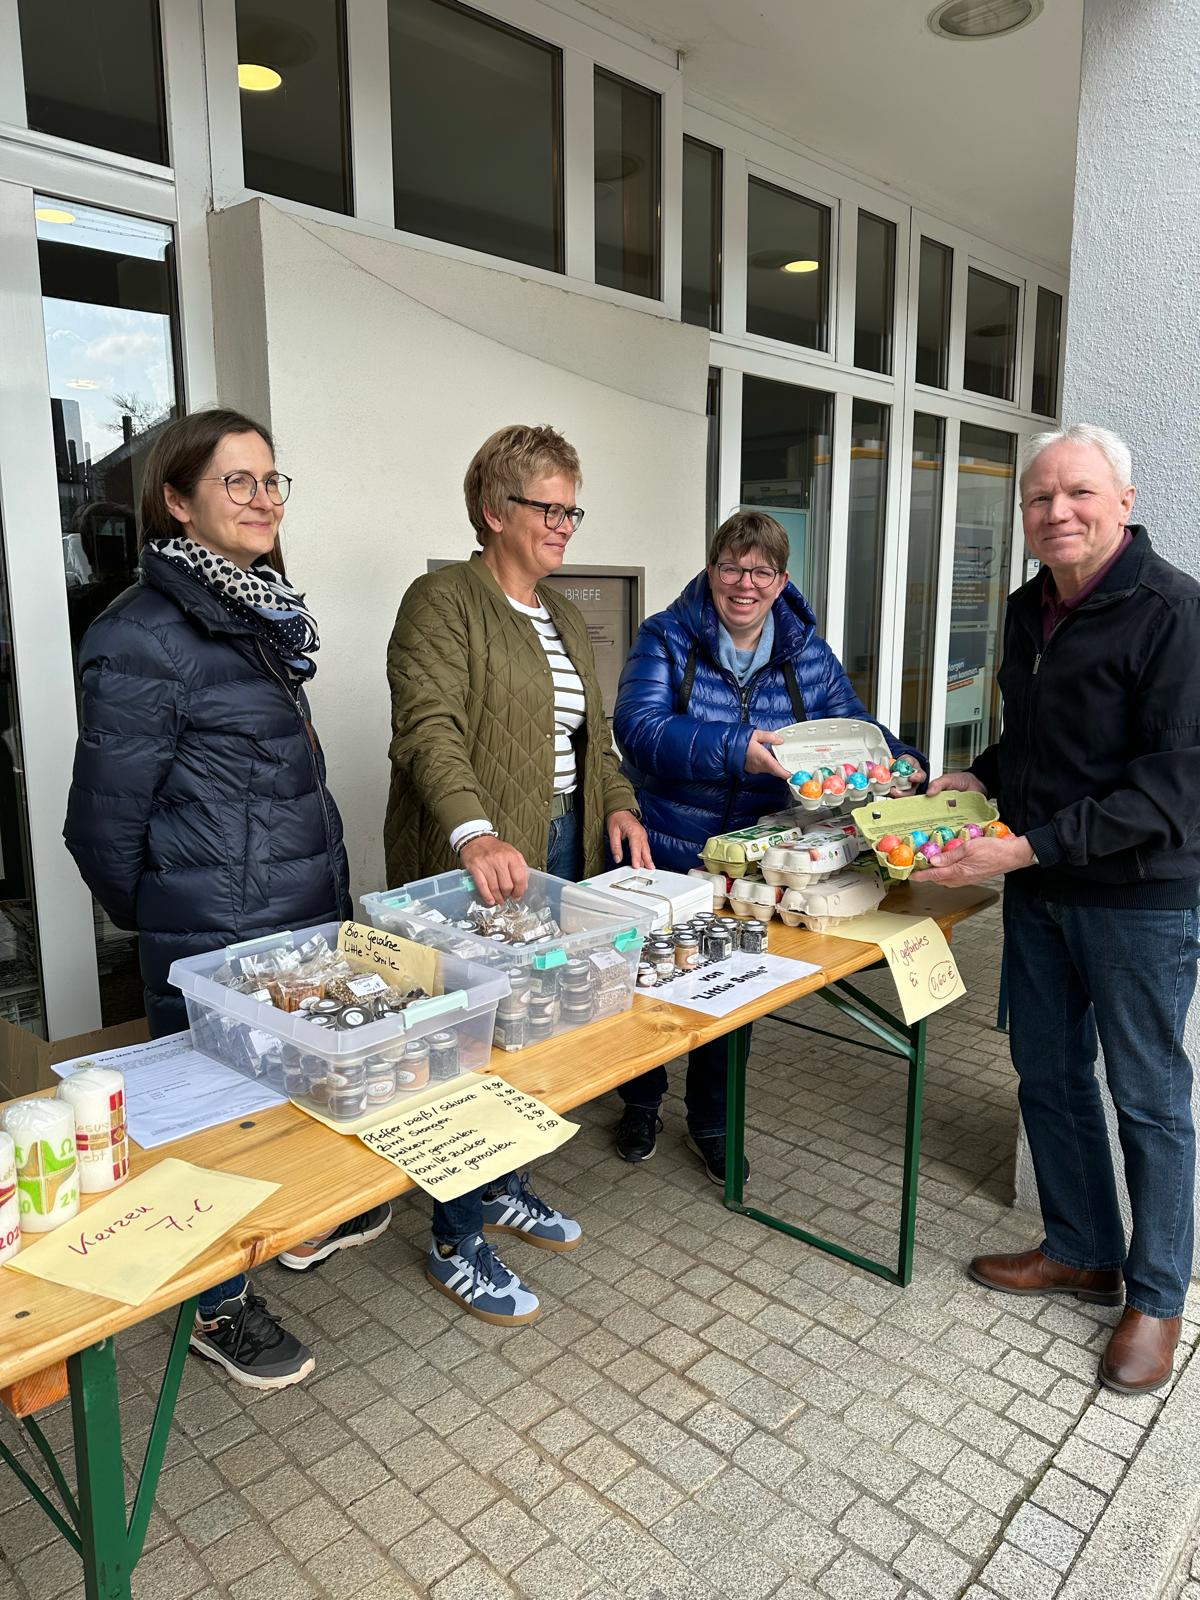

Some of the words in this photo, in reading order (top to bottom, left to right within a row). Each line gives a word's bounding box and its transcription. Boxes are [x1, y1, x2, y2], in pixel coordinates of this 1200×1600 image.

[565, 588, 601, 601] BRIEFE
[344, 922, 359, 938] Bio
[344, 940, 363, 957] Little
[373, 951, 400, 971] Smile
[698, 970, 725, 983] von
[76, 1122, 110, 1134] esus
[363, 1125, 401, 1145] Pfeffer
[404, 1110, 432, 1131] weiß
[376, 1135, 406, 1153] Zimt
[387, 1137, 433, 1160] Nelken
[398, 1139, 427, 1167] Zimt
[428, 1127, 479, 1157] gemahlen
[464, 1139, 517, 1171] gemahlen
[68, 1204, 154, 1256] Kerzen
